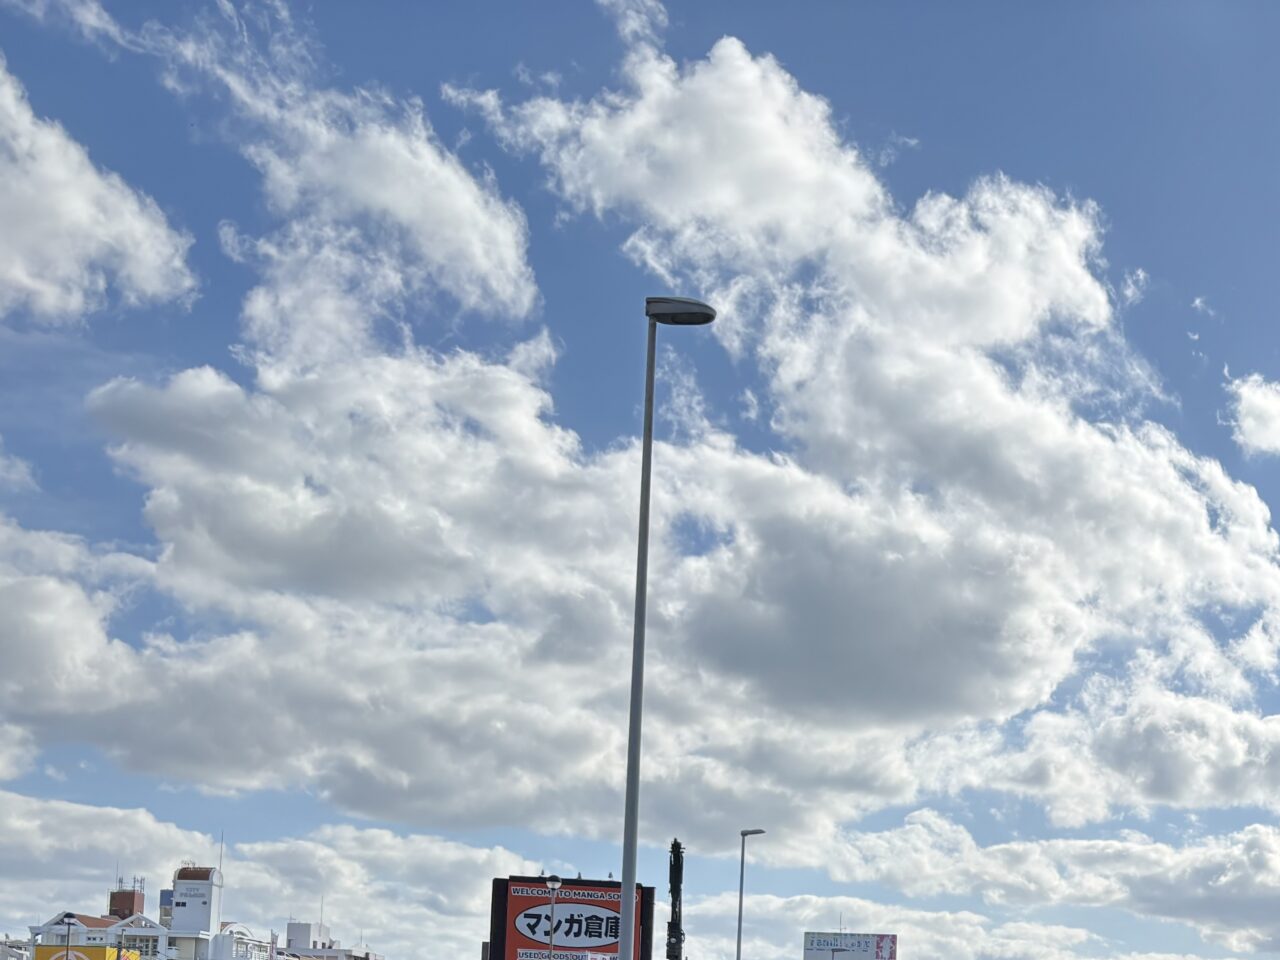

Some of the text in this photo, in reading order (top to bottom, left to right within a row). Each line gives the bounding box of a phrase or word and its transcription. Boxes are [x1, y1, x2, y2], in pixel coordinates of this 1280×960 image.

[512, 888, 553, 897] WELCOM
[573, 891, 605, 900] MANGA
[523, 912, 620, 939] マンガ倉庫
